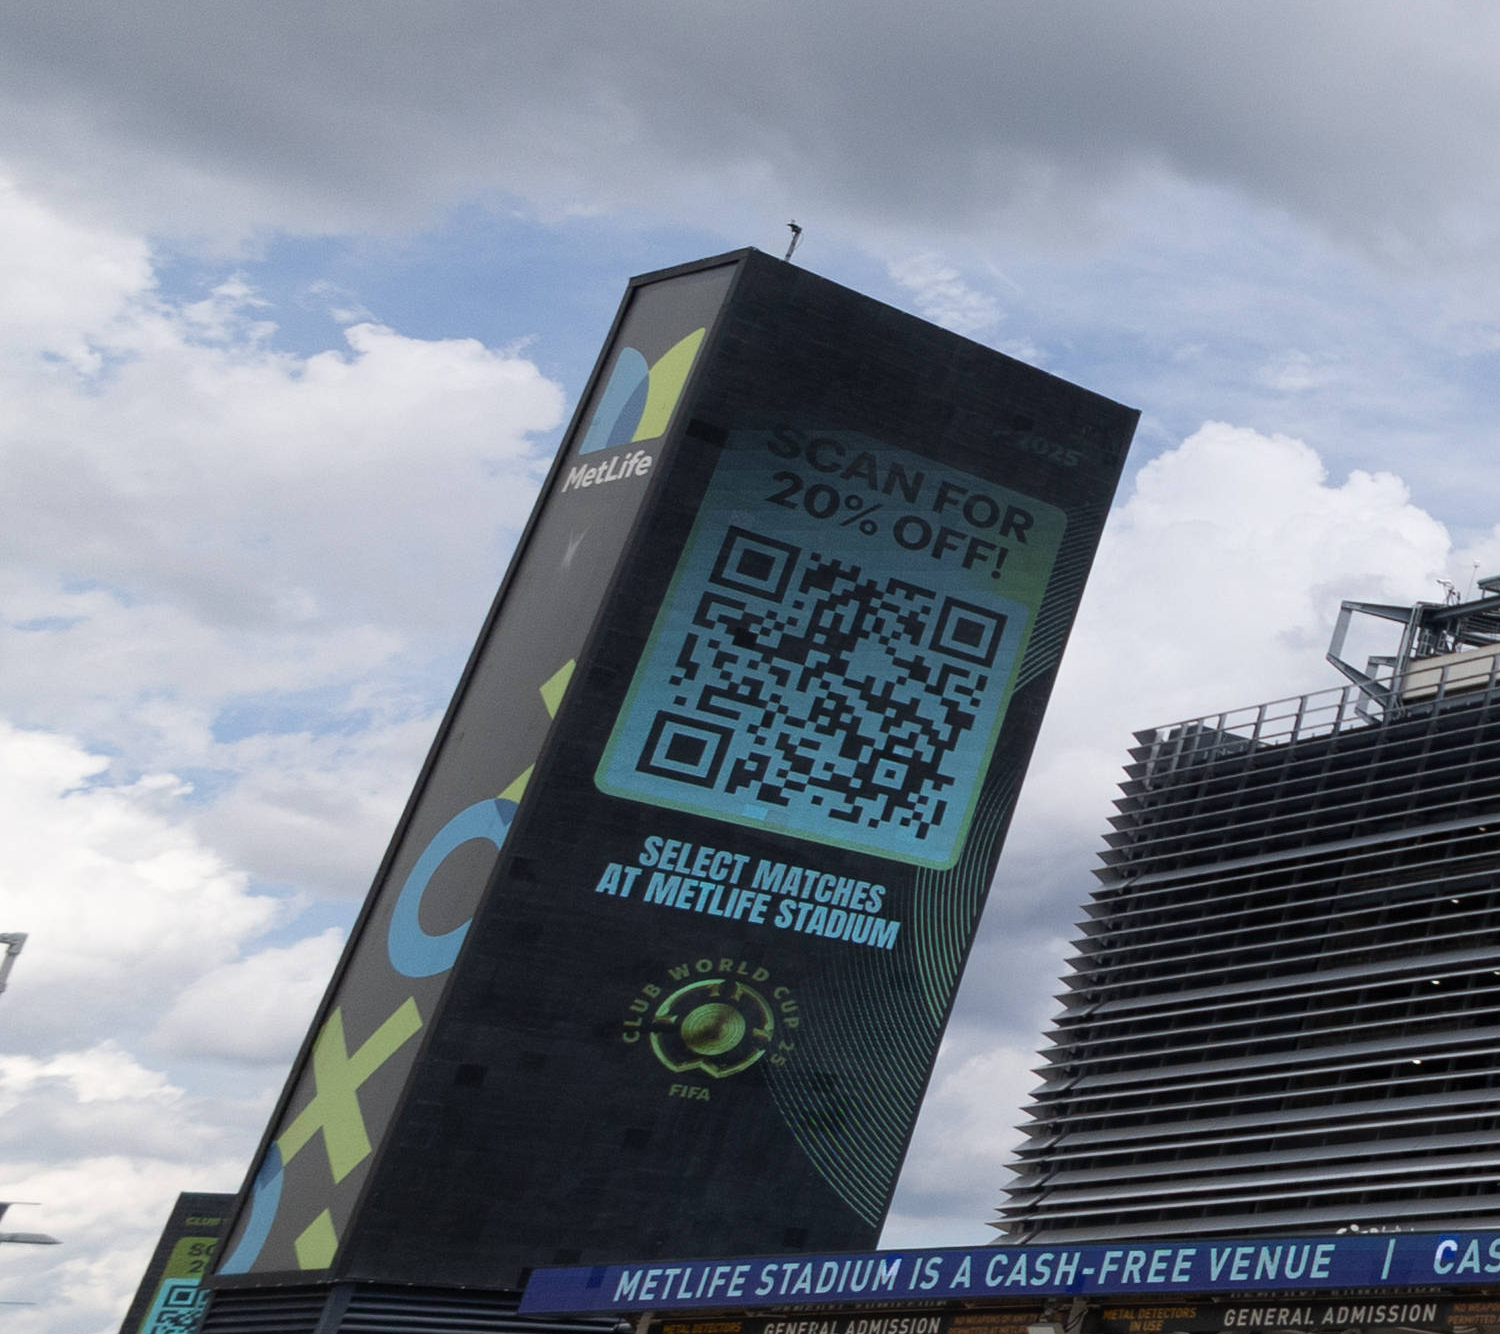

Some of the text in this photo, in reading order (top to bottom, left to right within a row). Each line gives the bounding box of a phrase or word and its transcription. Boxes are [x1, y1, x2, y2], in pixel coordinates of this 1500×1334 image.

[562, 450, 652, 491] MetLife
[765, 423, 1035, 544] SCAN FOR
[765, 470, 1010, 579] 20% OFF!
[595, 862, 900, 950] AT METLIFE STADIUM
[639, 835, 886, 914] SELECT MATCHES
[623, 984, 661, 1044] CLUB
[667, 959, 770, 982] WORLD
[773, 987, 800, 1028] CUP
[669, 1084, 711, 1101] FIFA
[613, 1265, 750, 1302] METLIFE
[756, 1258, 902, 1296] STADIUM
[909, 1256, 943, 1290] IS
[949, 1255, 973, 1289] A
[985, 1248, 1198, 1287] CASH-FREE
[1209, 1244, 1335, 1282] VENUE
[1223, 1304, 1436, 1327] GENERAL ADMISSION
